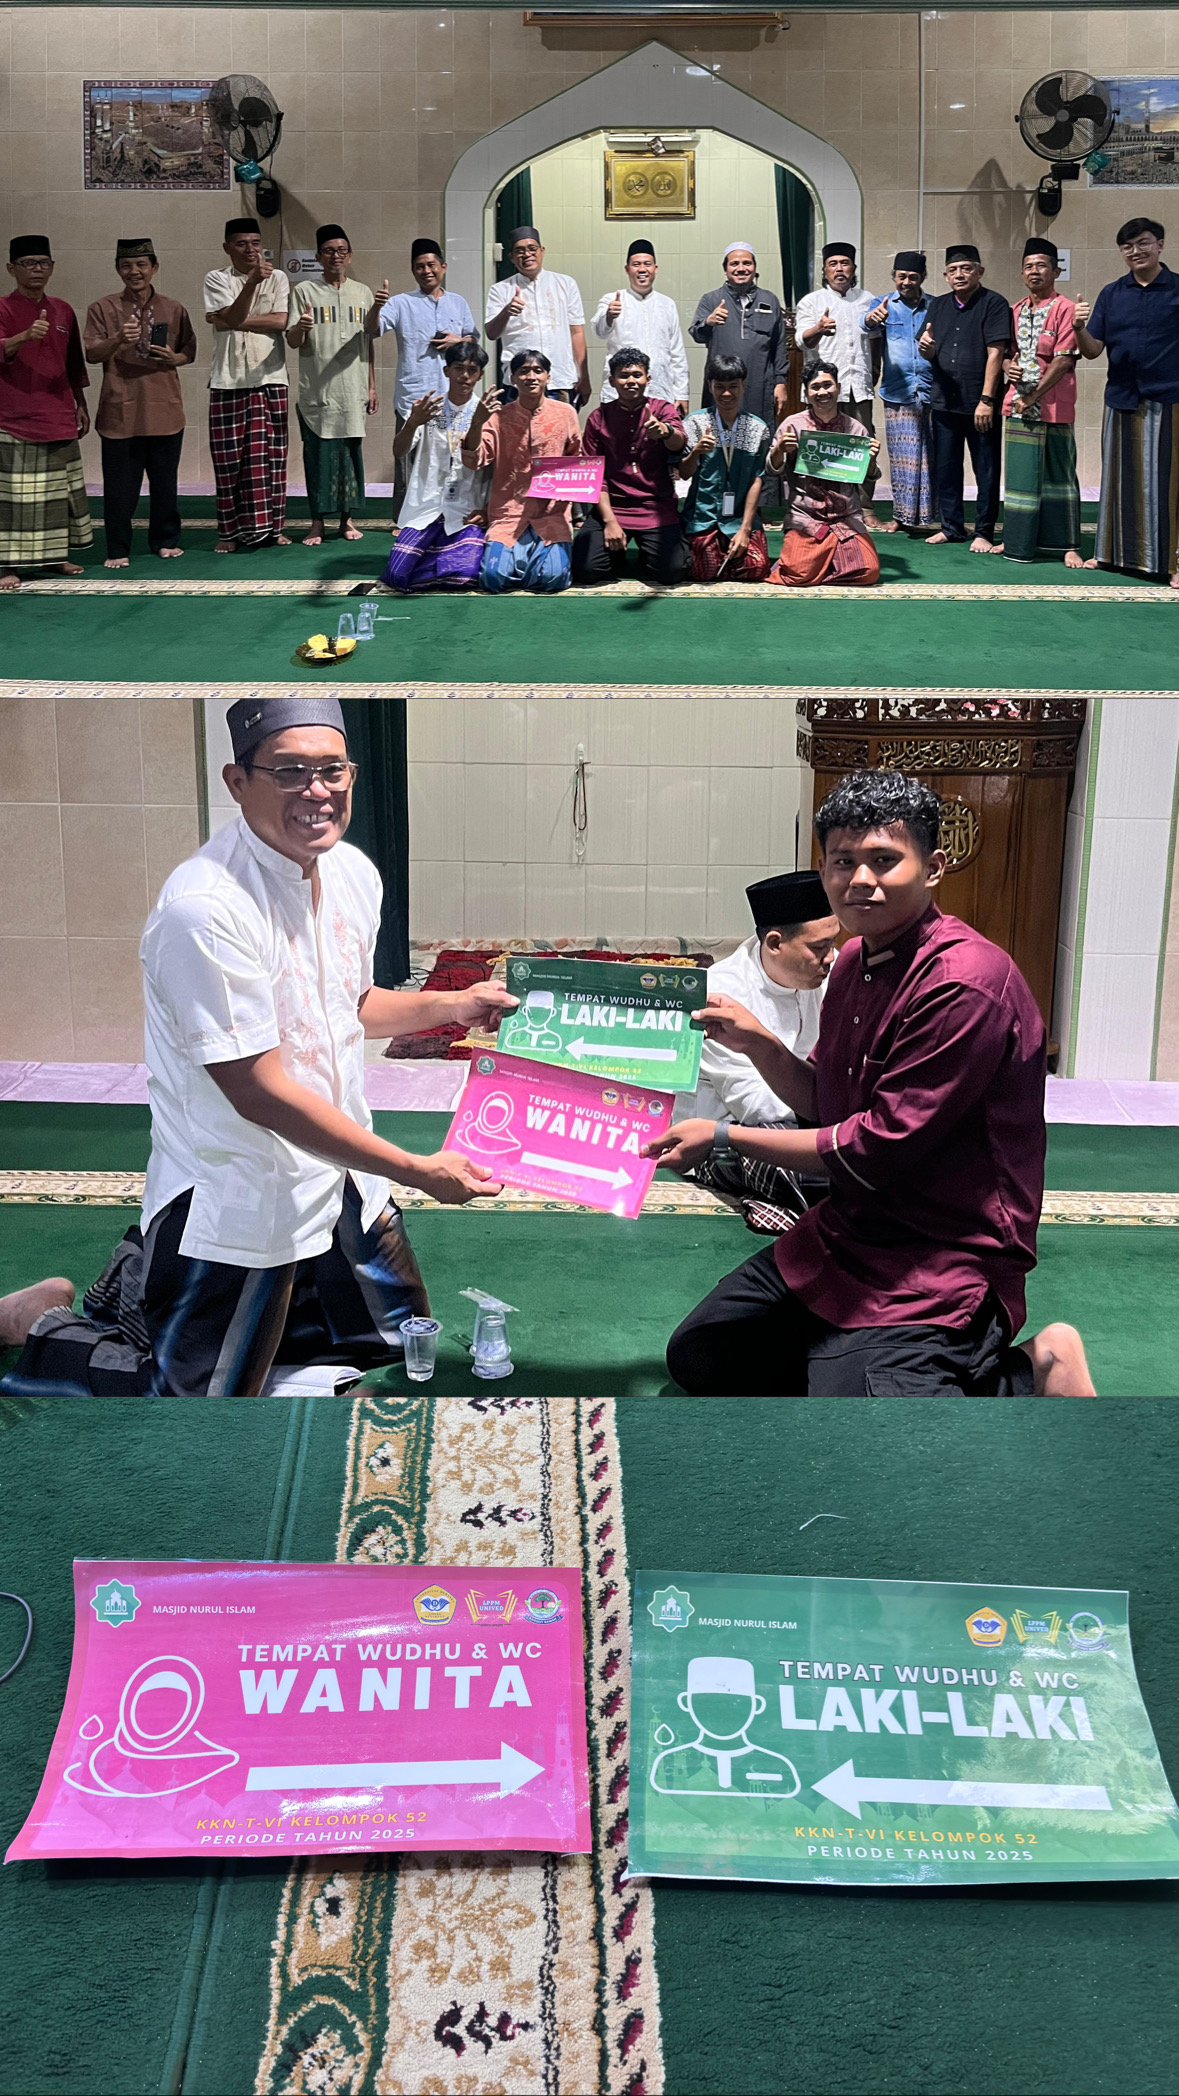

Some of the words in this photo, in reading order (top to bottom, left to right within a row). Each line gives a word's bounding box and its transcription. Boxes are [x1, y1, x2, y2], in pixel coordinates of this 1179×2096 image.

[819, 445, 865, 462] LAKI-LAKI
[555, 472, 596, 481] WANITA
[564, 992, 606, 1003] TEMPAT
[609, 995, 651, 1007] WUDHU
[654, 999, 661, 1007] &
[665, 999, 683, 1008] WC
[560, 1003, 684, 1032] LAKI-LAKI
[528, 1094, 572, 1112] TEMPAT
[574, 1105, 618, 1124] WUDHU
[620, 1118, 627, 1127] &
[632, 1120, 651, 1132] WC
[526, 1105, 639, 1155] WANITA
[152, 1605, 187, 1616] MASJID
[189, 1605, 224, 1614] NURUL
[226, 1605, 256, 1614] ISLAM
[698, 1617, 732, 1627] MASJID
[734, 1619, 766, 1628] NURUL
[768, 1621, 797, 1630] ISLAM
[238, 1644, 346, 1662] TEMPAT
[357, 1643, 461, 1661] WUDHU
[471, 1642, 488, 1659] &
[498, 1642, 542, 1659] WC
[778, 1660, 884, 1682] TEMPAT
[894, 1665, 998, 1687] WUDHU
[1008, 1670, 1027, 1688] &
[1034, 1671, 1079, 1690] WC
[238, 1665, 533, 1715] WANITA
[778, 1684, 1095, 1741] LAKI-LAKI
[196, 1817, 282, 1830] KKN-T-VI
[290, 1812, 399, 1827] KELOMPOK
[405, 1811, 427, 1823] 52
[200, 1833, 286, 1845] PERIODE
[294, 1830, 362, 1842] TAHUN
[370, 1828, 415, 1839] 2025
[794, 1826, 885, 1840] KKN-T-VI
[893, 1829, 1007, 1844] KELOMPOK
[1014, 1833, 1039, 1844] 52
[807, 1845, 896, 1859] PERIODE
[903, 1848, 977, 1860] TAHUN
[985, 1850, 1033, 1861] 2025
